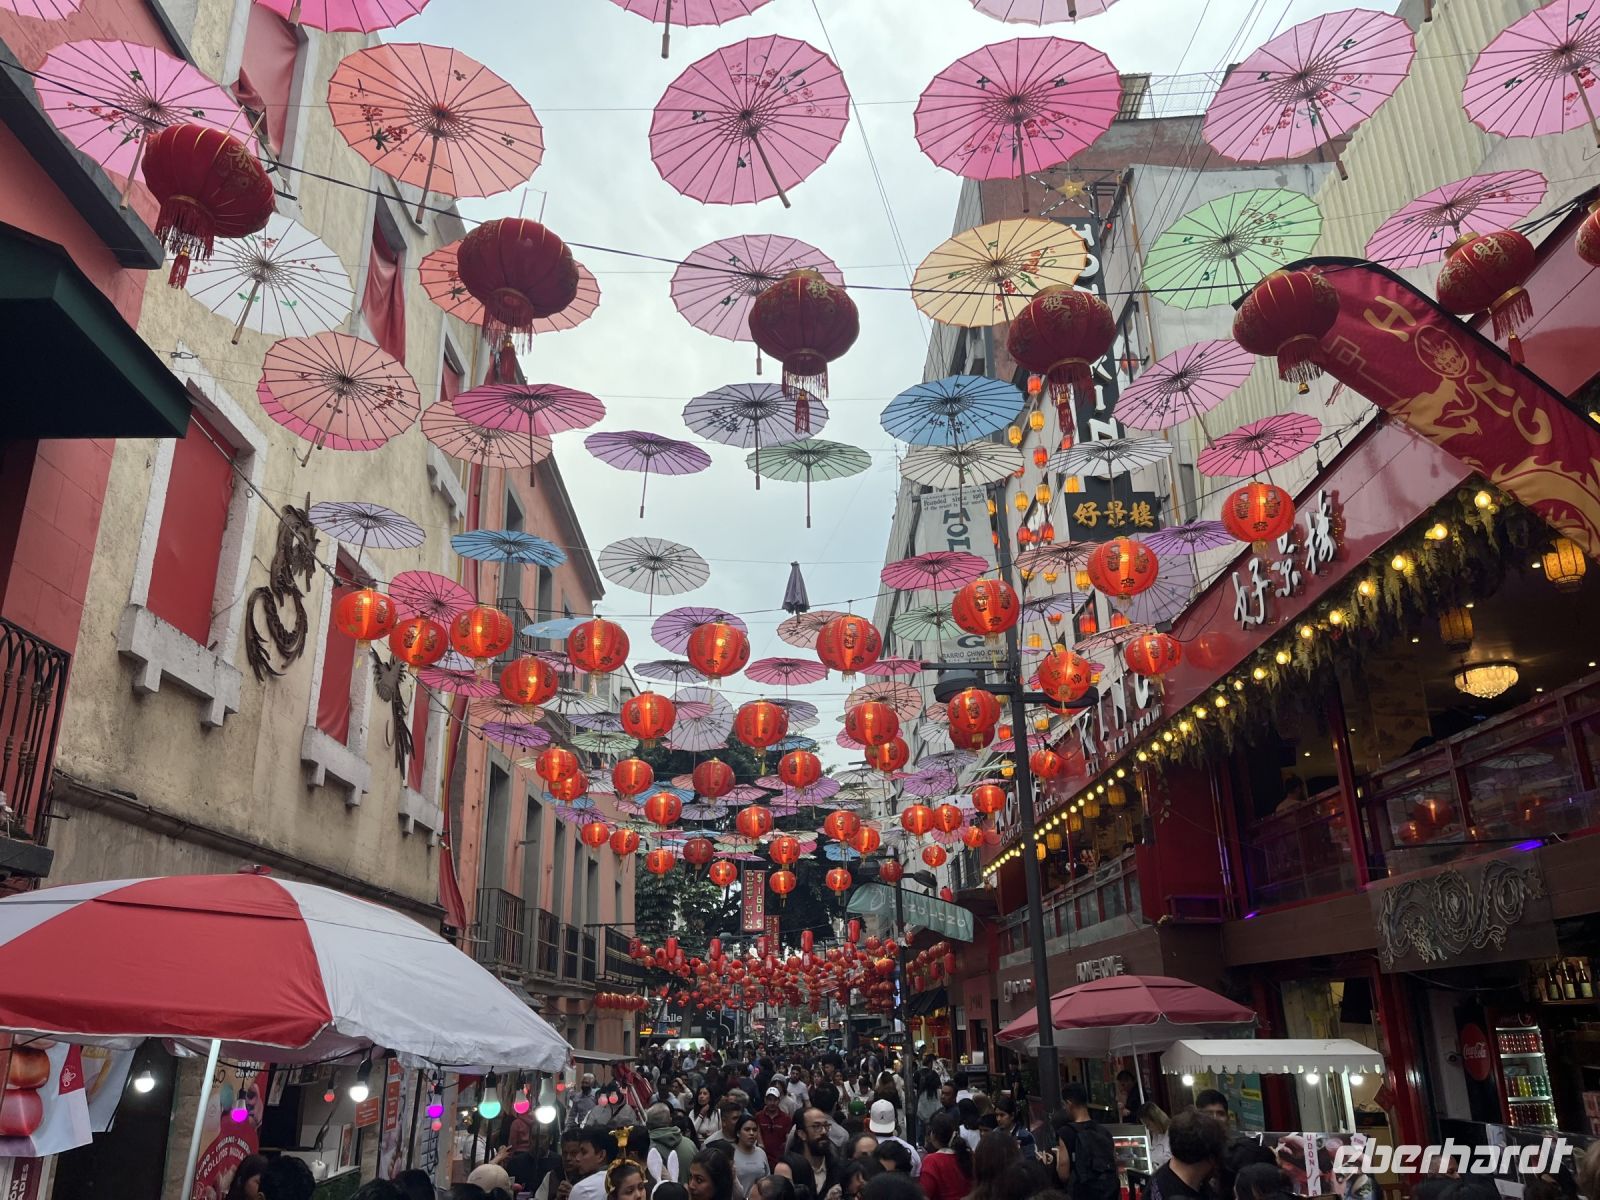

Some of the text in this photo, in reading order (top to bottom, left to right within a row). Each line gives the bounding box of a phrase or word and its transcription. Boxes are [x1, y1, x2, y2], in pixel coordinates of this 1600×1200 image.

[1074, 502, 1155, 528] 好景樓
[1306, 1134, 1315, 1166] UDON
